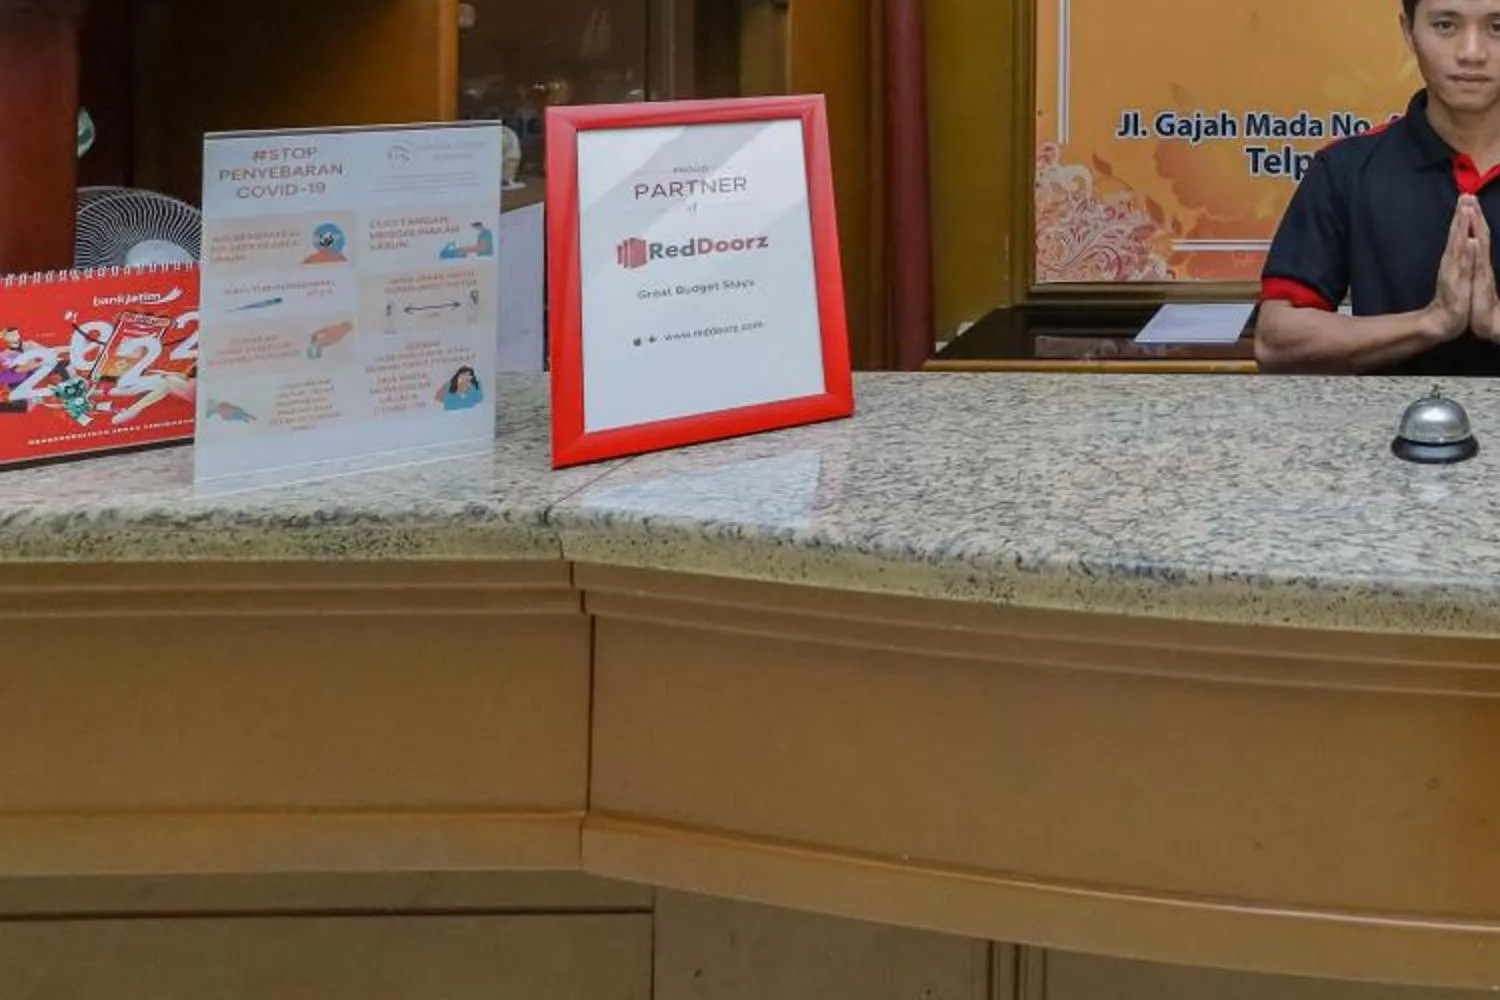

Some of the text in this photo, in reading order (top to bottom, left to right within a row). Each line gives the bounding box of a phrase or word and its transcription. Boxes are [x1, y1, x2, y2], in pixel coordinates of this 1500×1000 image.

[1118, 113, 1147, 137] Jl.
[1155, 113, 1237, 142] Gajah
[1246, 113, 1323, 137] Mada
[252, 146, 318, 162] #STOP
[219, 163, 344, 182] PENYEBARAN
[634, 176, 748, 201] PARTNER
[649, 236, 770, 261] RedDoorz
[637, 279, 756, 300] Great Budget Stays
